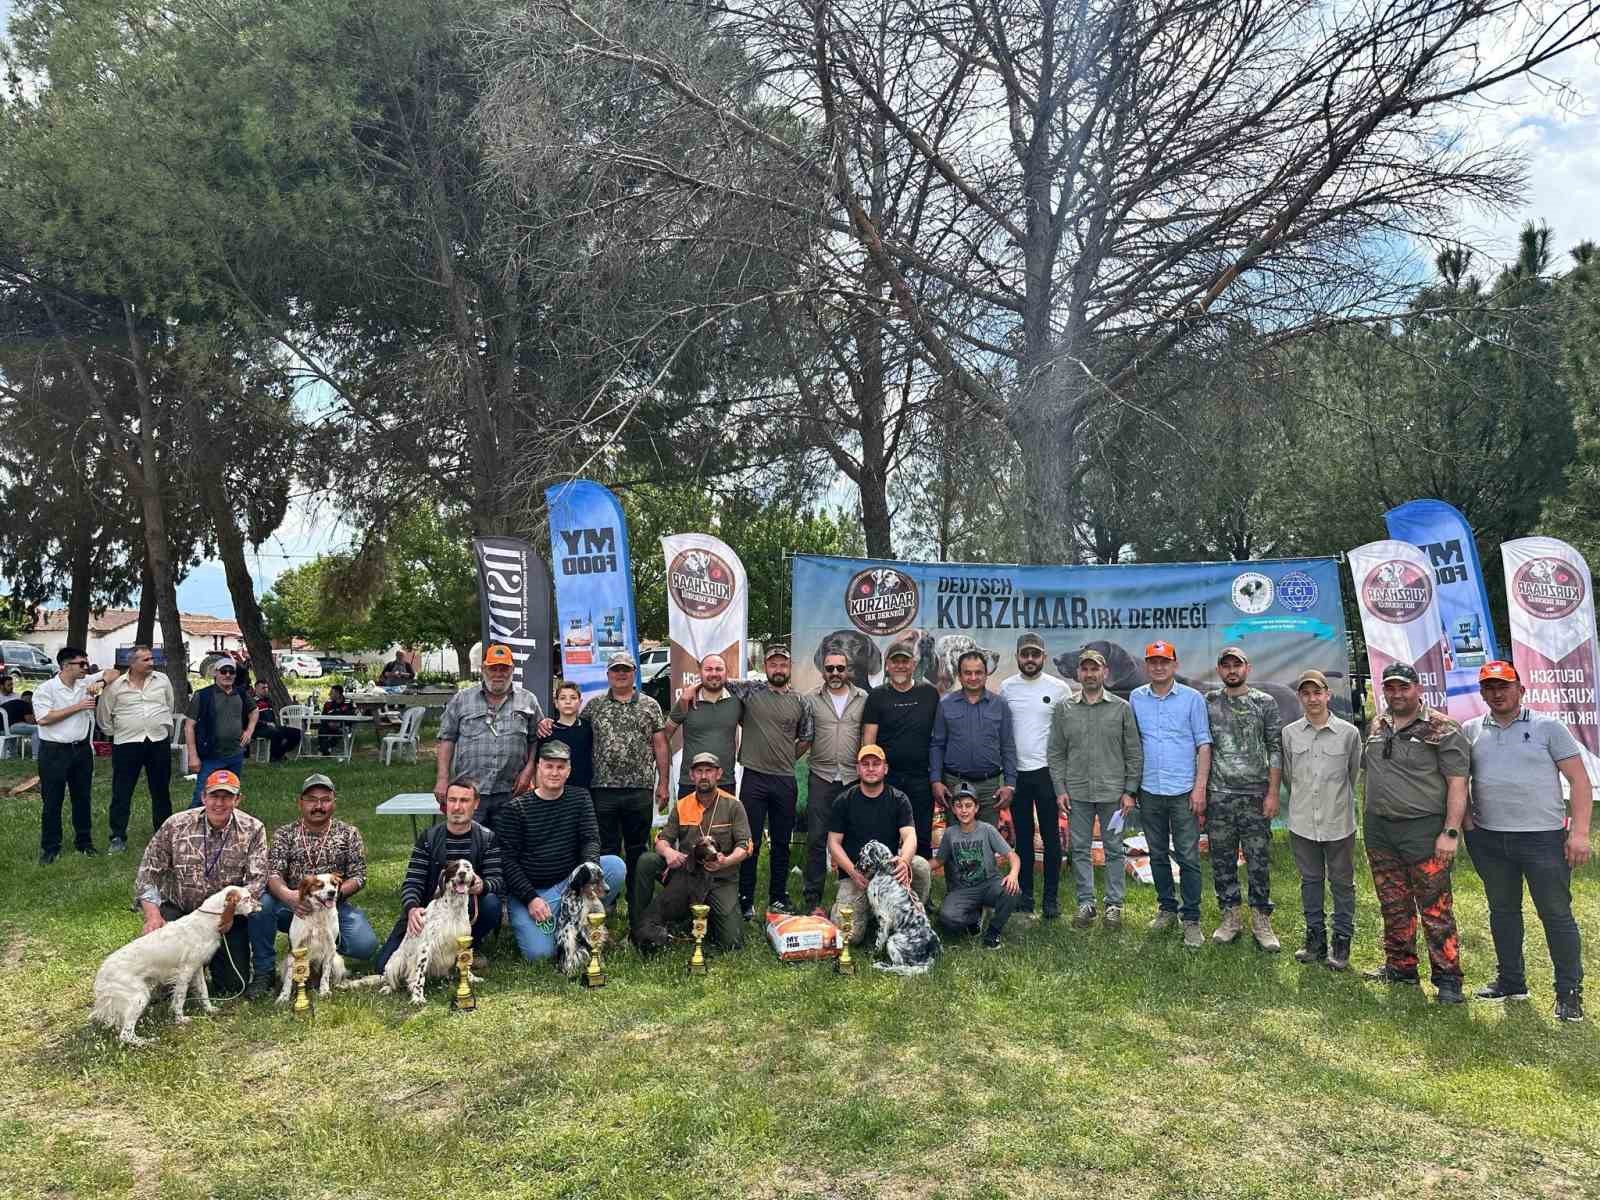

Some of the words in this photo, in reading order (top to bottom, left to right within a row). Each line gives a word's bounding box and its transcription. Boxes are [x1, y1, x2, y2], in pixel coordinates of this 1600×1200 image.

[938, 576, 1012, 596] DEUTSCH
[850, 591, 914, 615] KURZHAAR
[937, 596, 1089, 629] KURZHAAR
[1091, 608, 1122, 629] IRK
[1129, 603, 1207, 629] DERNEĞİ
